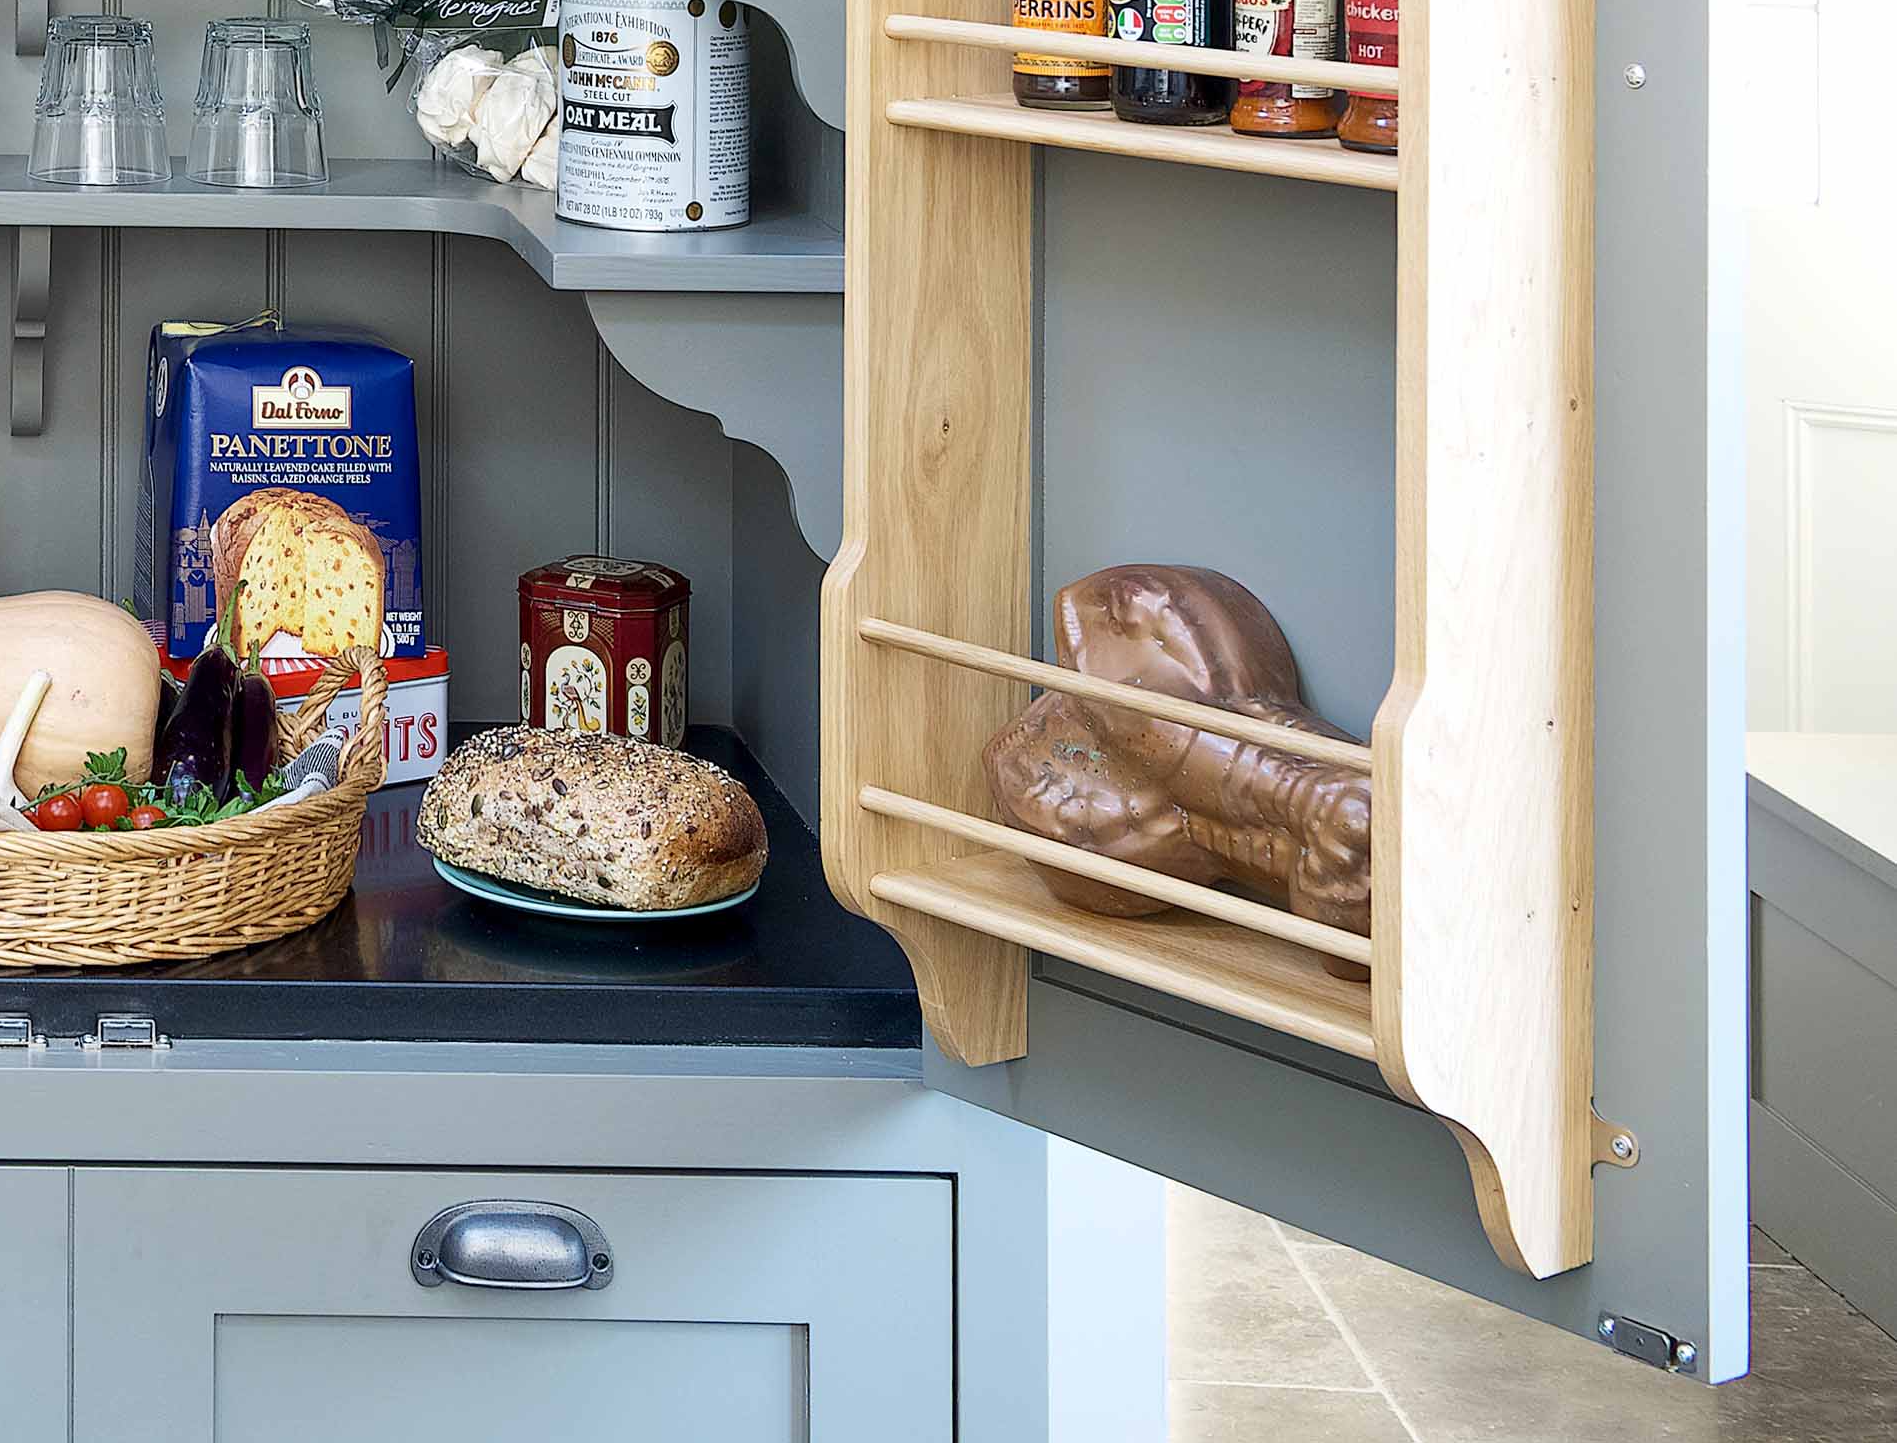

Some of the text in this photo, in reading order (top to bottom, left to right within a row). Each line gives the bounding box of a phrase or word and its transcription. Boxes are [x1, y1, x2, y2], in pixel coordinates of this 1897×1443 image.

[615, 11, 671, 39] EXHIBITION
[591, 30, 619, 44] 1876
[1358, 44, 1384, 60] HOT
[567, 70, 594, 86] JOHN
[583, 89, 631, 102] STEEL CUT
[565, 105, 662, 132] OAT MEAL
[635, 150, 682, 163] COMMISSION
[565, 165, 606, 181] PHILADELPHIA
[583, 204, 591, 214] 28
[591, 204, 600, 216] OZ
[619, 208, 628, 218] 12
[644, 208, 663, 221] 793g
[261, 400, 344, 420] Dal Forno
[209, 433, 393, 459] PANETTONE
[210, 461, 393, 473] NATURALLY LEAVENED CAKE FILLED WITH
[231, 473, 372, 485] RAISINS, GLAZED ORANGE PEELS
[386, 611, 422, 622] NET WEIGHT
[396, 635, 410, 644] 500
